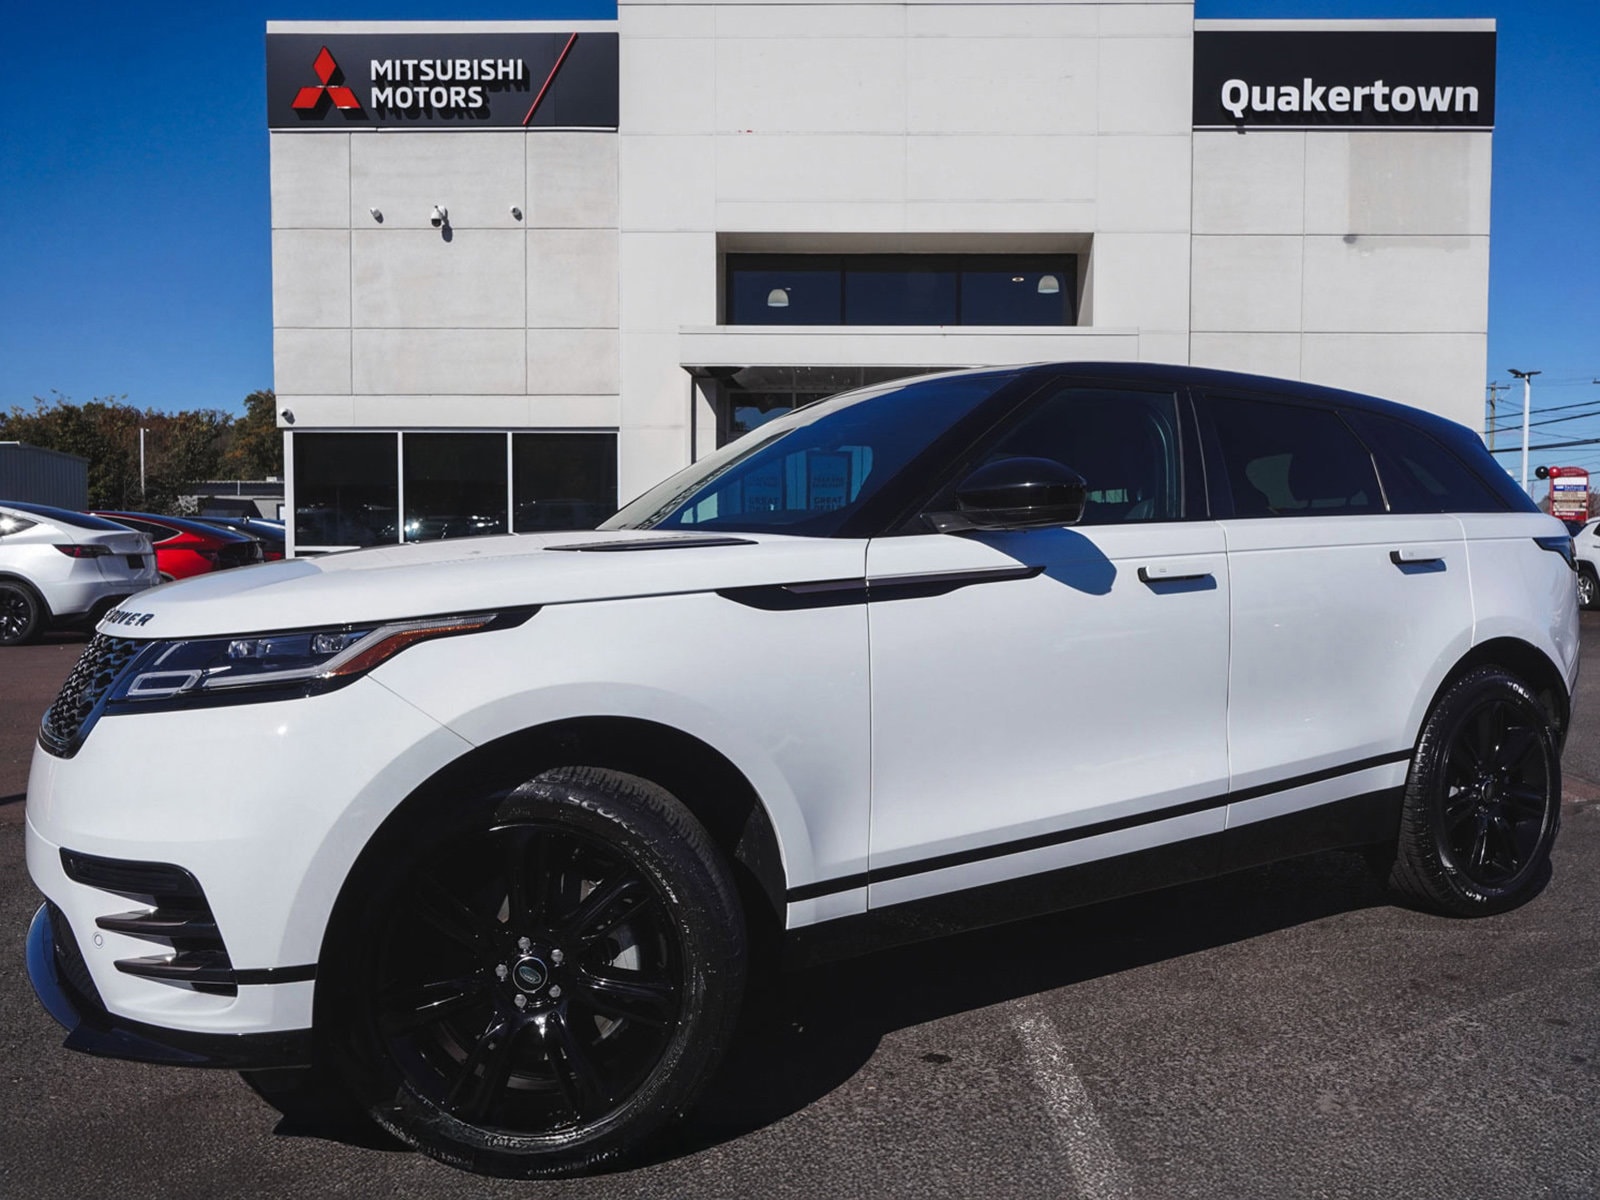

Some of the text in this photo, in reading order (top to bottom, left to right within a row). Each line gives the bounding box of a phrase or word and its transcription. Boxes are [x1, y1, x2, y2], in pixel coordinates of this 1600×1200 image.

[370, 58, 523, 81] MITSUBISHI
[370, 86, 483, 109] MOTORS
[1221, 78, 1479, 118] Quakertown
